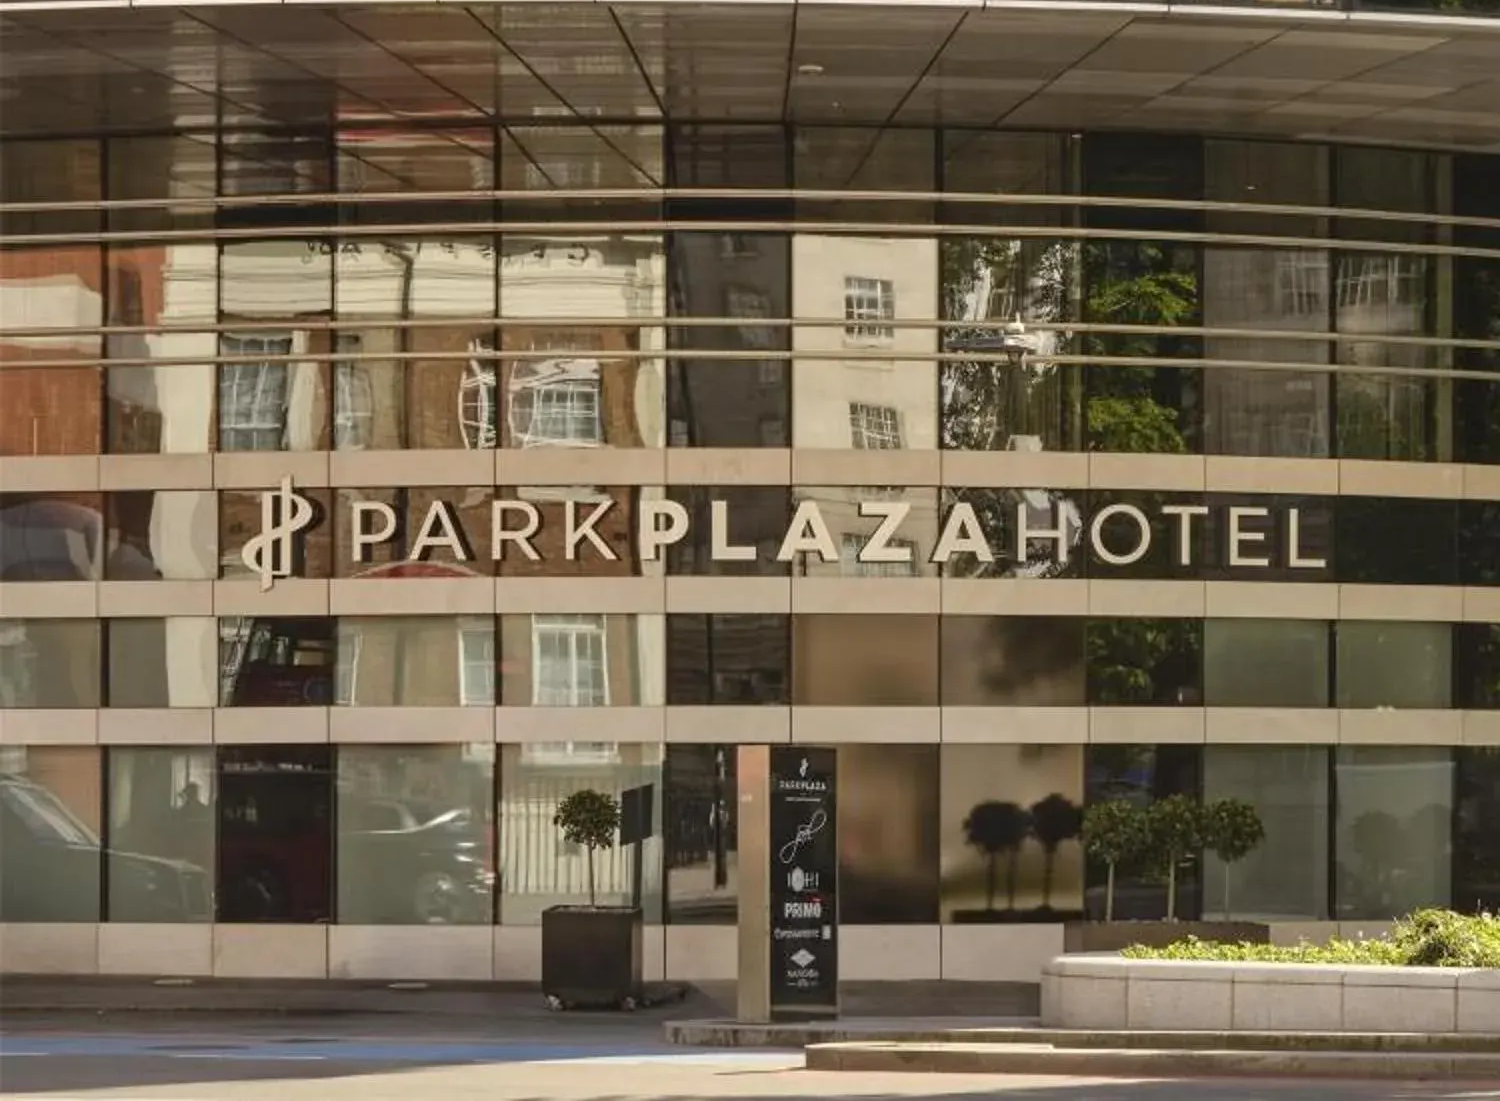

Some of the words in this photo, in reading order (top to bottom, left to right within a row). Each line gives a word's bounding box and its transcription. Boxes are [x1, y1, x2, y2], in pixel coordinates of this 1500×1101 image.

[351, 499, 617, 562] PARK
[639, 499, 996, 563] PLAZA
[1017, 501, 1328, 569] HOTEL
[784, 902, 822, 918] PRIMO
